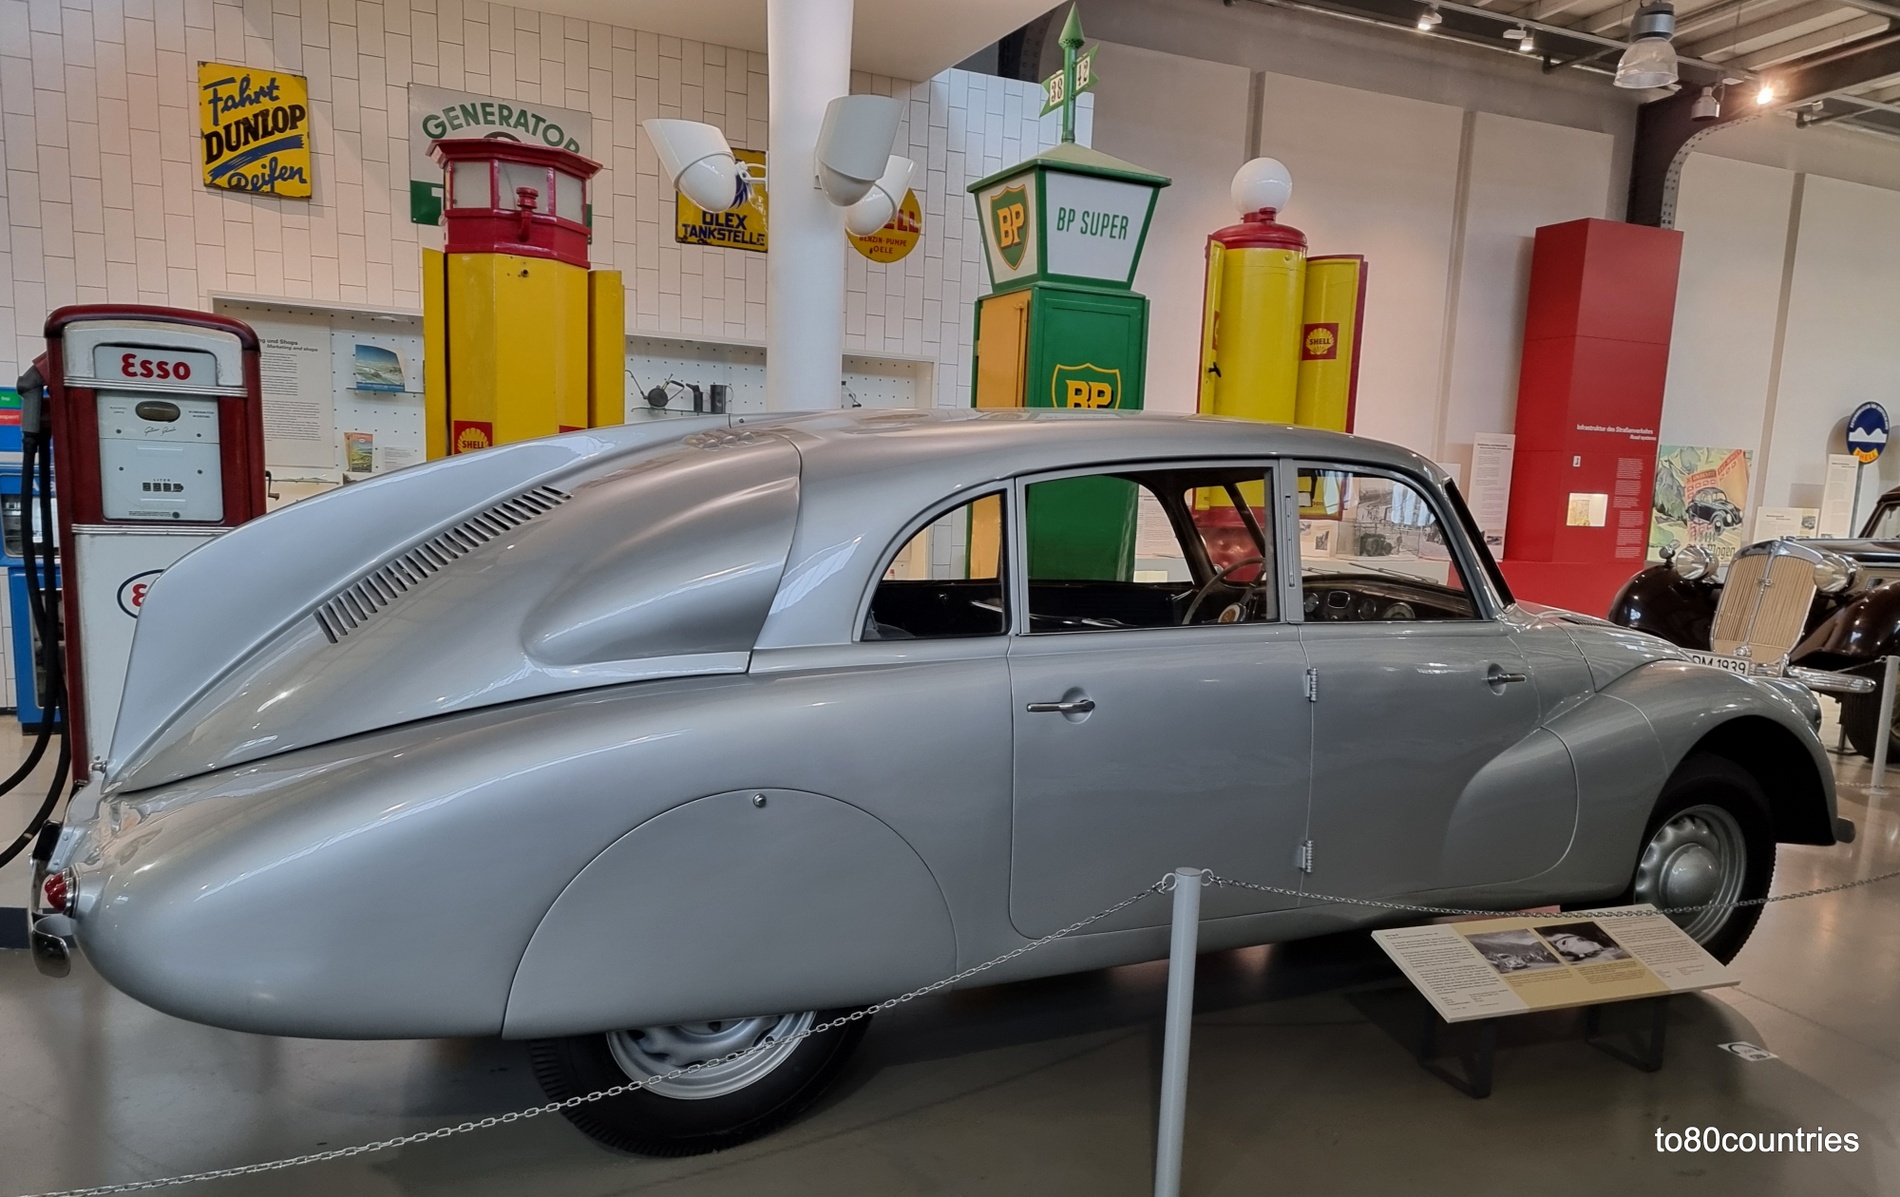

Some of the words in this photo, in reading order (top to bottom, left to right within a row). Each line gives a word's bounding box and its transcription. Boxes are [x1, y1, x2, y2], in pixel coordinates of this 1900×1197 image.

[203, 75, 280, 126] Fahrt
[204, 104, 306, 165] DUNLOP
[227, 156, 308, 193] Reifen
[702, 211, 747, 230] OLEX
[997, 202, 1025, 250] BP
[1056, 206, 1076, 232] BP
[1080, 210, 1129, 241] SUPER
[682, 223, 766, 246] TANKSTELLE
[873, 245, 893, 254] OELE
[1309, 337, 1331, 345] SHELL
[462, 440, 484, 449] SHELL
[1716, 658, 1747, 675] 1939
